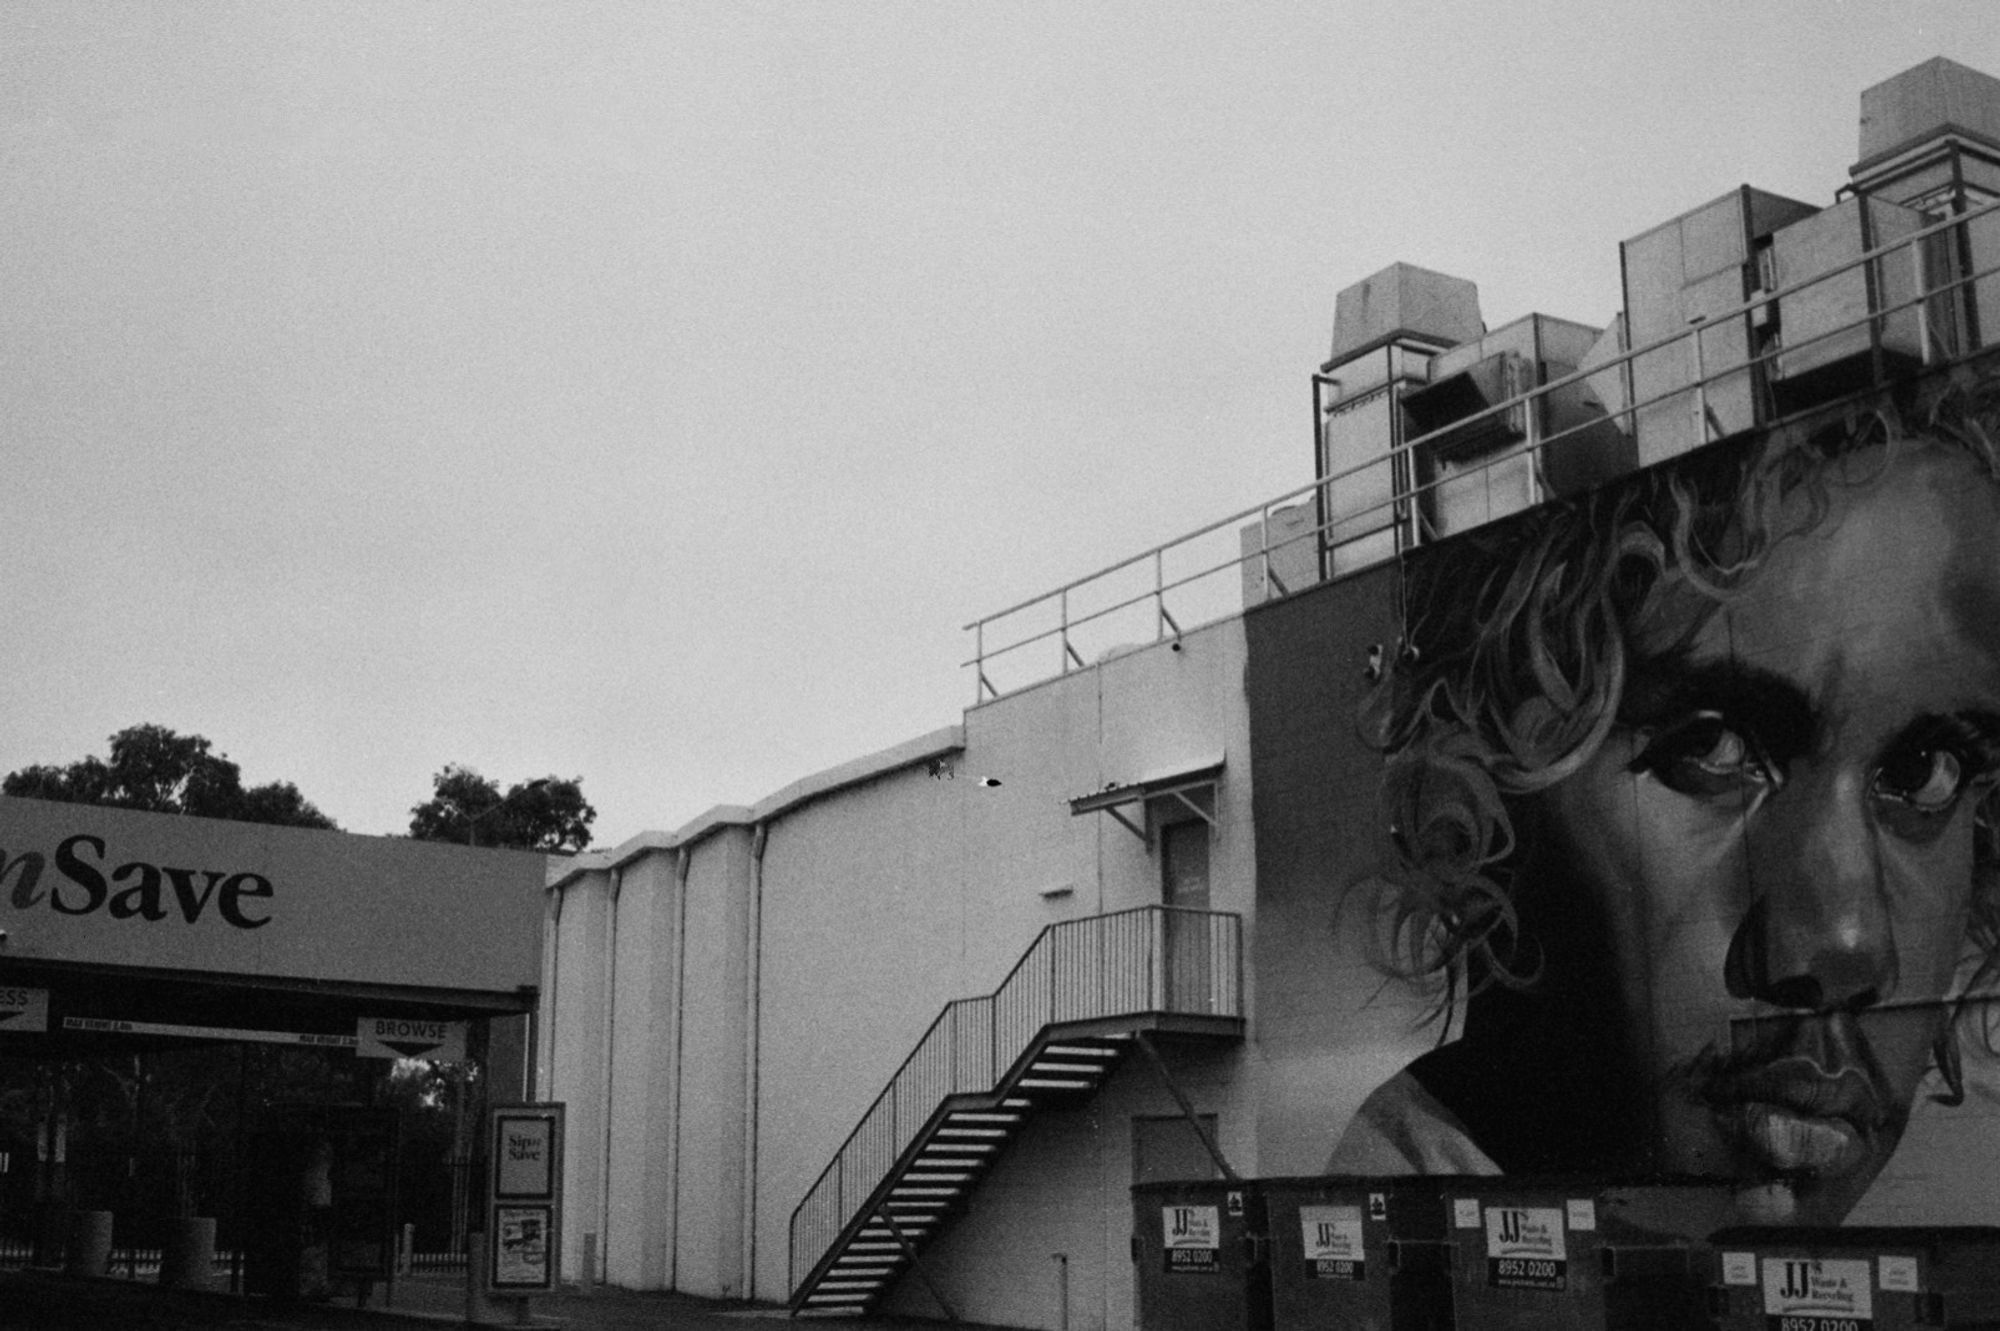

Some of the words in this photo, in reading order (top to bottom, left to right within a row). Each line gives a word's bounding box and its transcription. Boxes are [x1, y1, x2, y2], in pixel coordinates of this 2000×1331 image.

[375, 1020, 448, 1039] BROWSE
[1171, 1249, 1192, 1263] 8952
[1498, 1259, 1525, 1275] 8952
[1527, 1261, 1556, 1277] 0200
[1781, 1317, 1816, 1331] 8952
[1820, 1319, 1858, 1331] 0200
